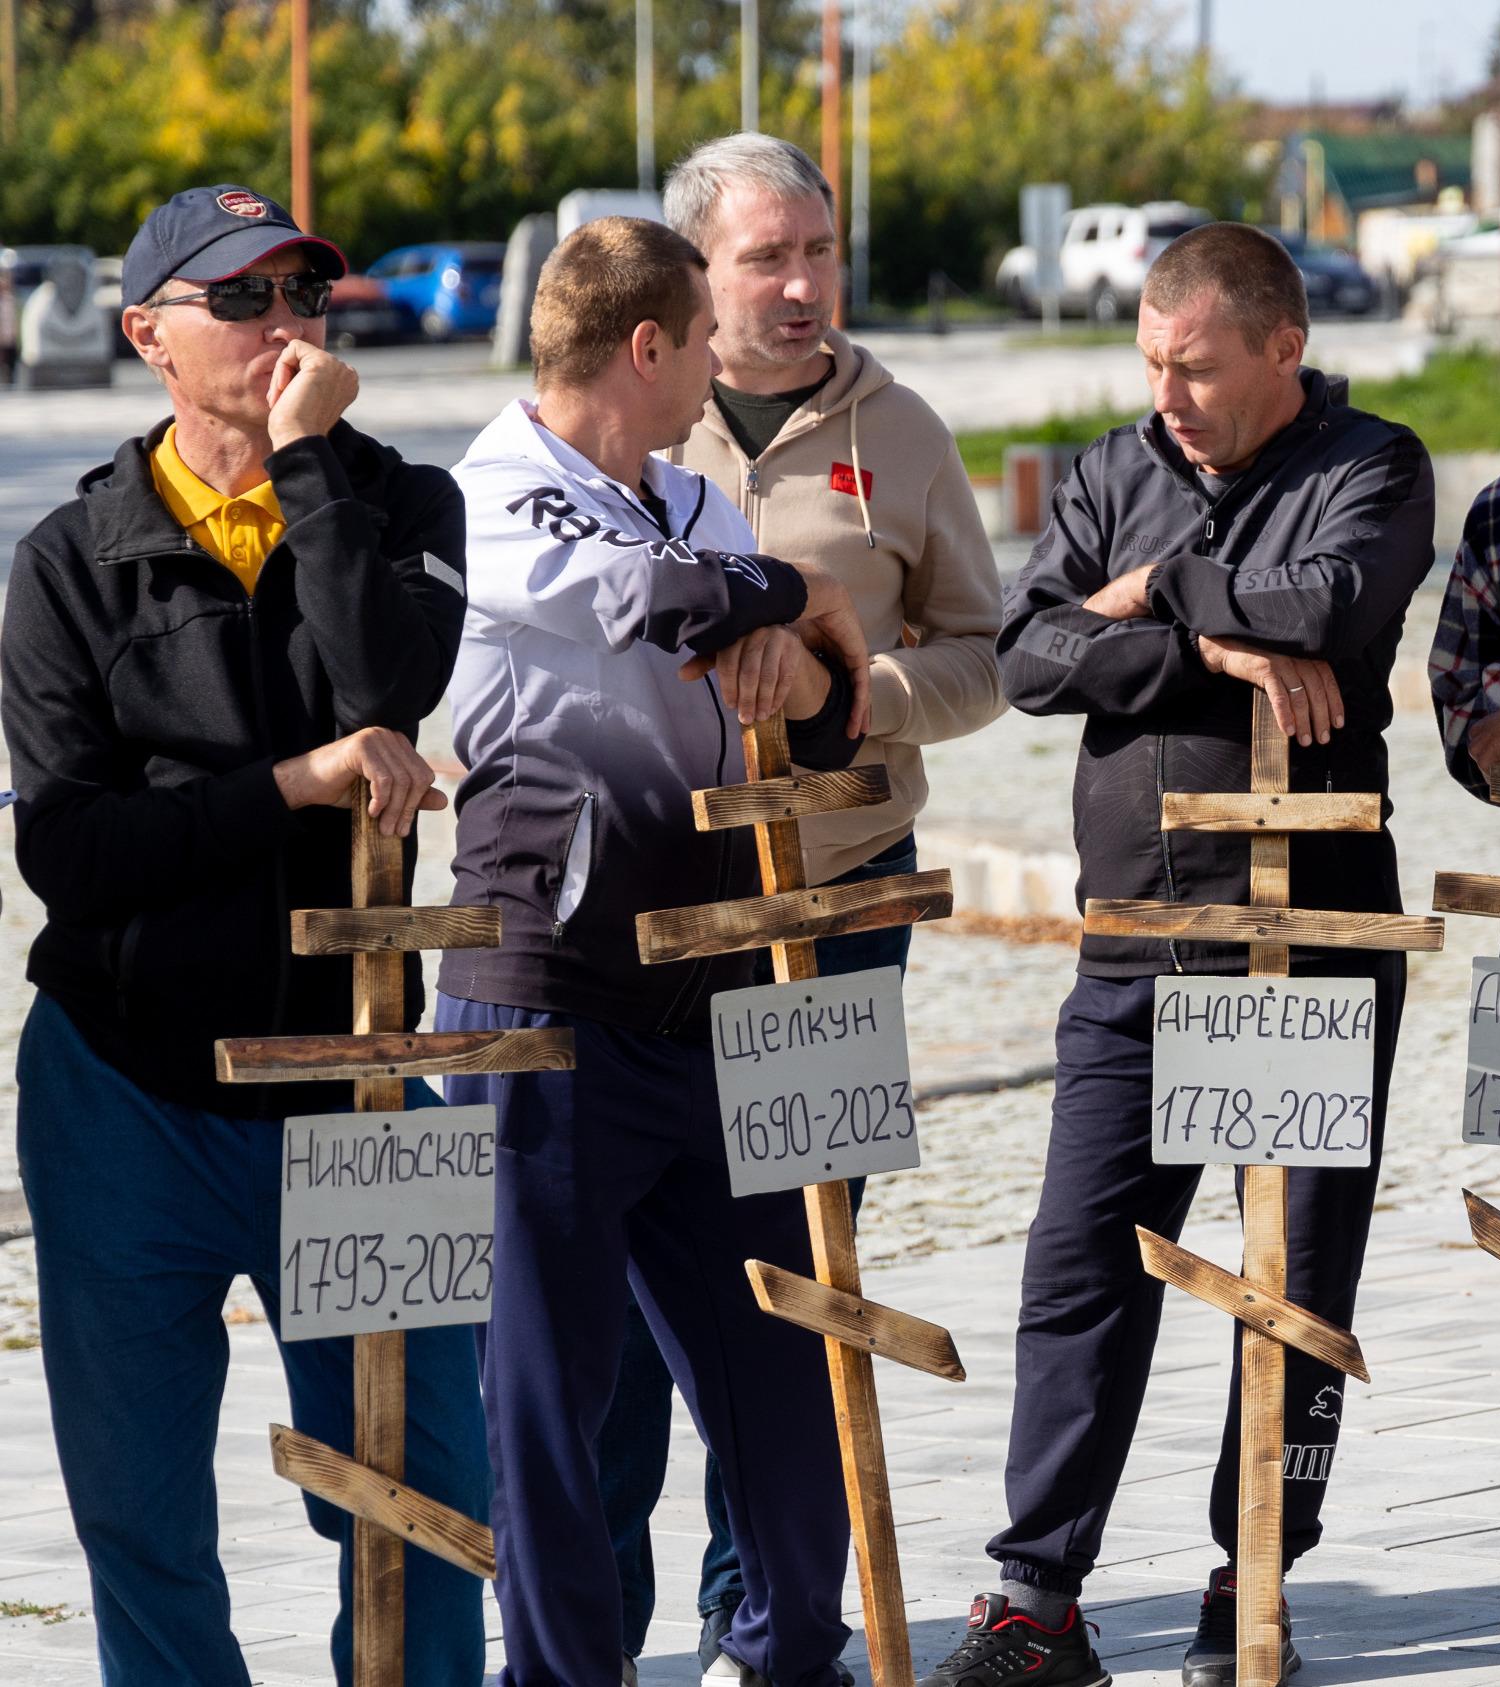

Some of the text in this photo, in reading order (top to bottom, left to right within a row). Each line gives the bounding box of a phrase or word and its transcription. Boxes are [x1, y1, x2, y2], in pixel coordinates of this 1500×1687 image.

[728, 1080, 916, 1162] 1690-2023
[1156, 1085, 1372, 1151] 1778-2023
[284, 1233, 495, 1316] 1793-2023
